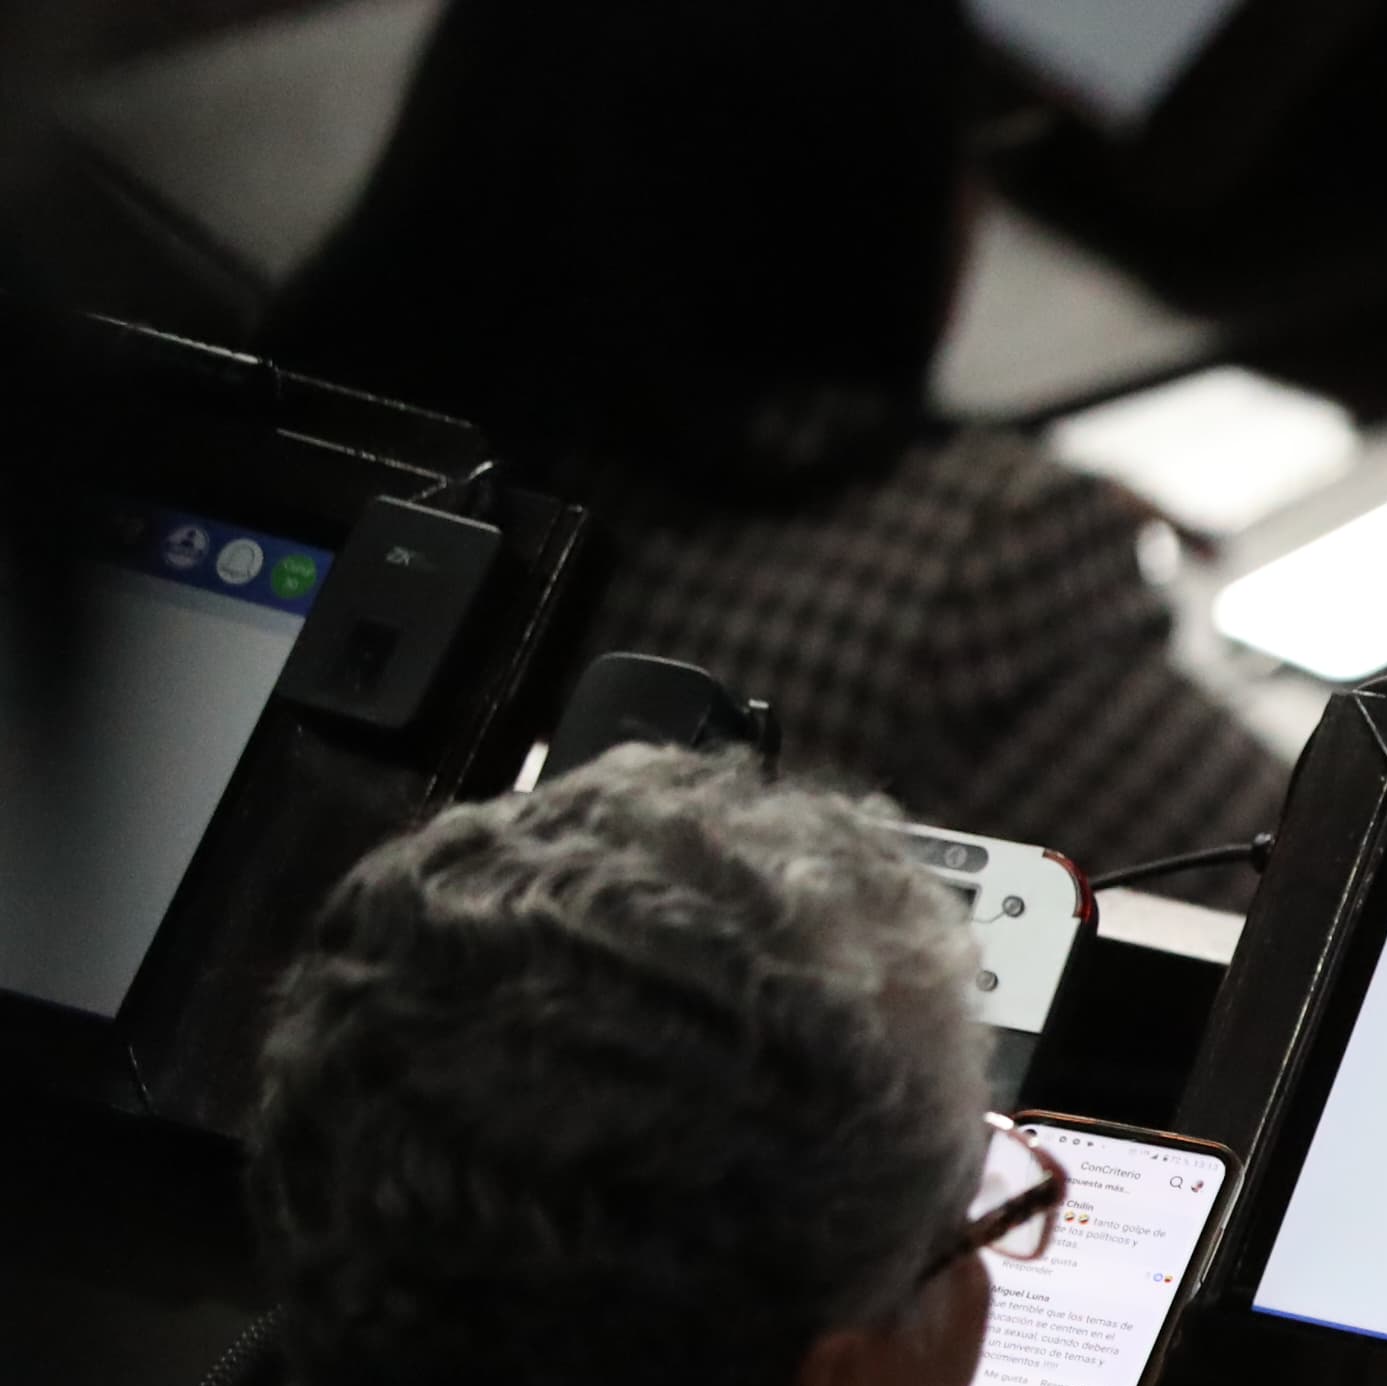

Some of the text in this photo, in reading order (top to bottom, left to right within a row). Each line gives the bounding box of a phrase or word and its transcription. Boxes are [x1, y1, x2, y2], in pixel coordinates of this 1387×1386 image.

[1081, 1160, 1141, 1181] ConCriterio
[1069, 1226, 1084, 1238] los
[1085, 1230, 1131, 1247] políticos
[1131, 1239, 1139, 1248] y
[1094, 1217, 1167, 1239] tanto golpe de
[1002, 1259, 1054, 1275] Responder
[991, 1285, 1051, 1303] Miguel Luna
[1007, 1301, 1045, 1315] terrible
[1046, 1309, 1066, 1321] que
[1067, 1311, 1083, 1322] los
[1085, 1315, 1118, 1329] temas
[1120, 1321, 1134, 1332] de
[1035, 1319, 1049, 1329] se
[1050, 1321, 1088, 1336] centren
[1090, 1329, 1104, 1339] en
[1105, 1332, 1116, 1341] el
[984, 1351, 1041, 1367] ocimientos
[988, 1338, 1106, 1369] un universo de temas y
